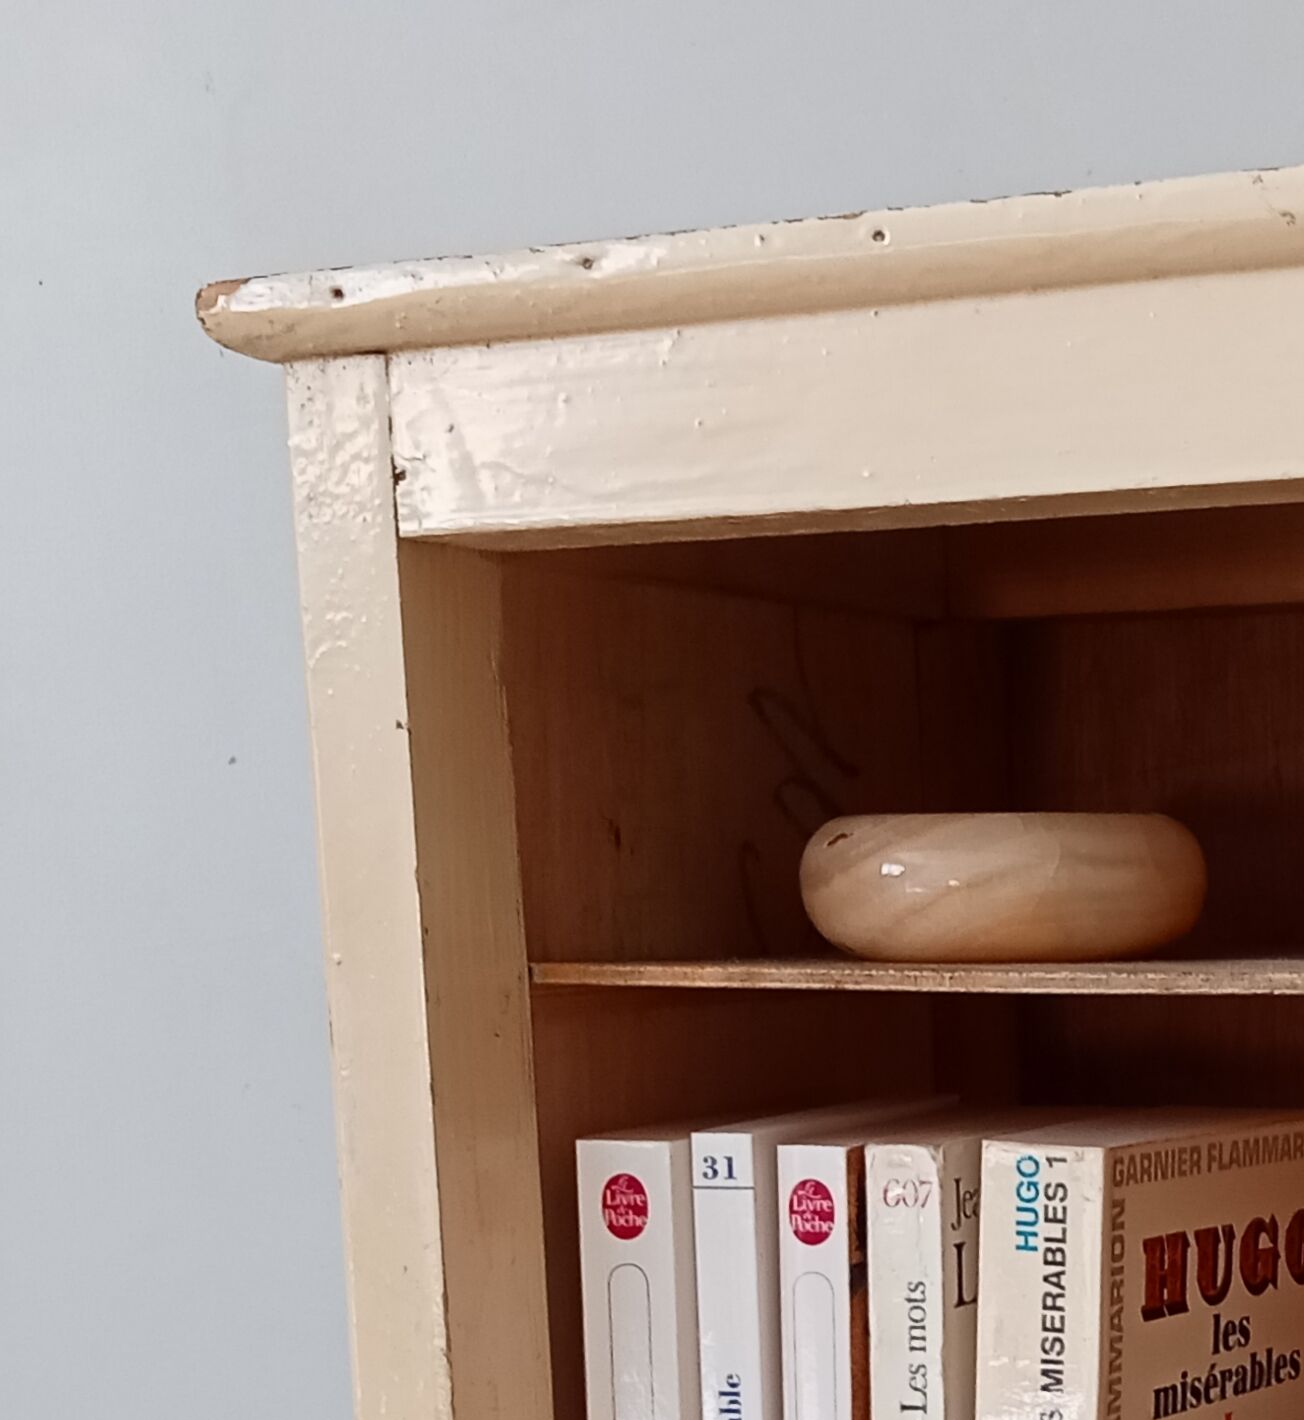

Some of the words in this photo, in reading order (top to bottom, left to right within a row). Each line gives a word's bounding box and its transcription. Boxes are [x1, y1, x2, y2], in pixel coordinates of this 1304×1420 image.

[701, 1155, 738, 1181] 31
[1046, 1155, 1068, 1168] 1
[1113, 1145, 1201, 1187] GARNIER
[604, 1209, 648, 1228] Poche
[606, 1190, 646, 1207] Livre
[792, 1195, 834, 1212] Livre
[1014, 1154, 1040, 1253] HUGO
[790, 1214, 834, 1234] Poche
[1040, 1182, 1068, 1393] MISERABLES
[904, 1280, 928, 1354] mots
[1212, 1313, 1250, 1355] les
[900, 1362, 928, 1415] Les
[1152, 1347, 1301, 1420] misérables
